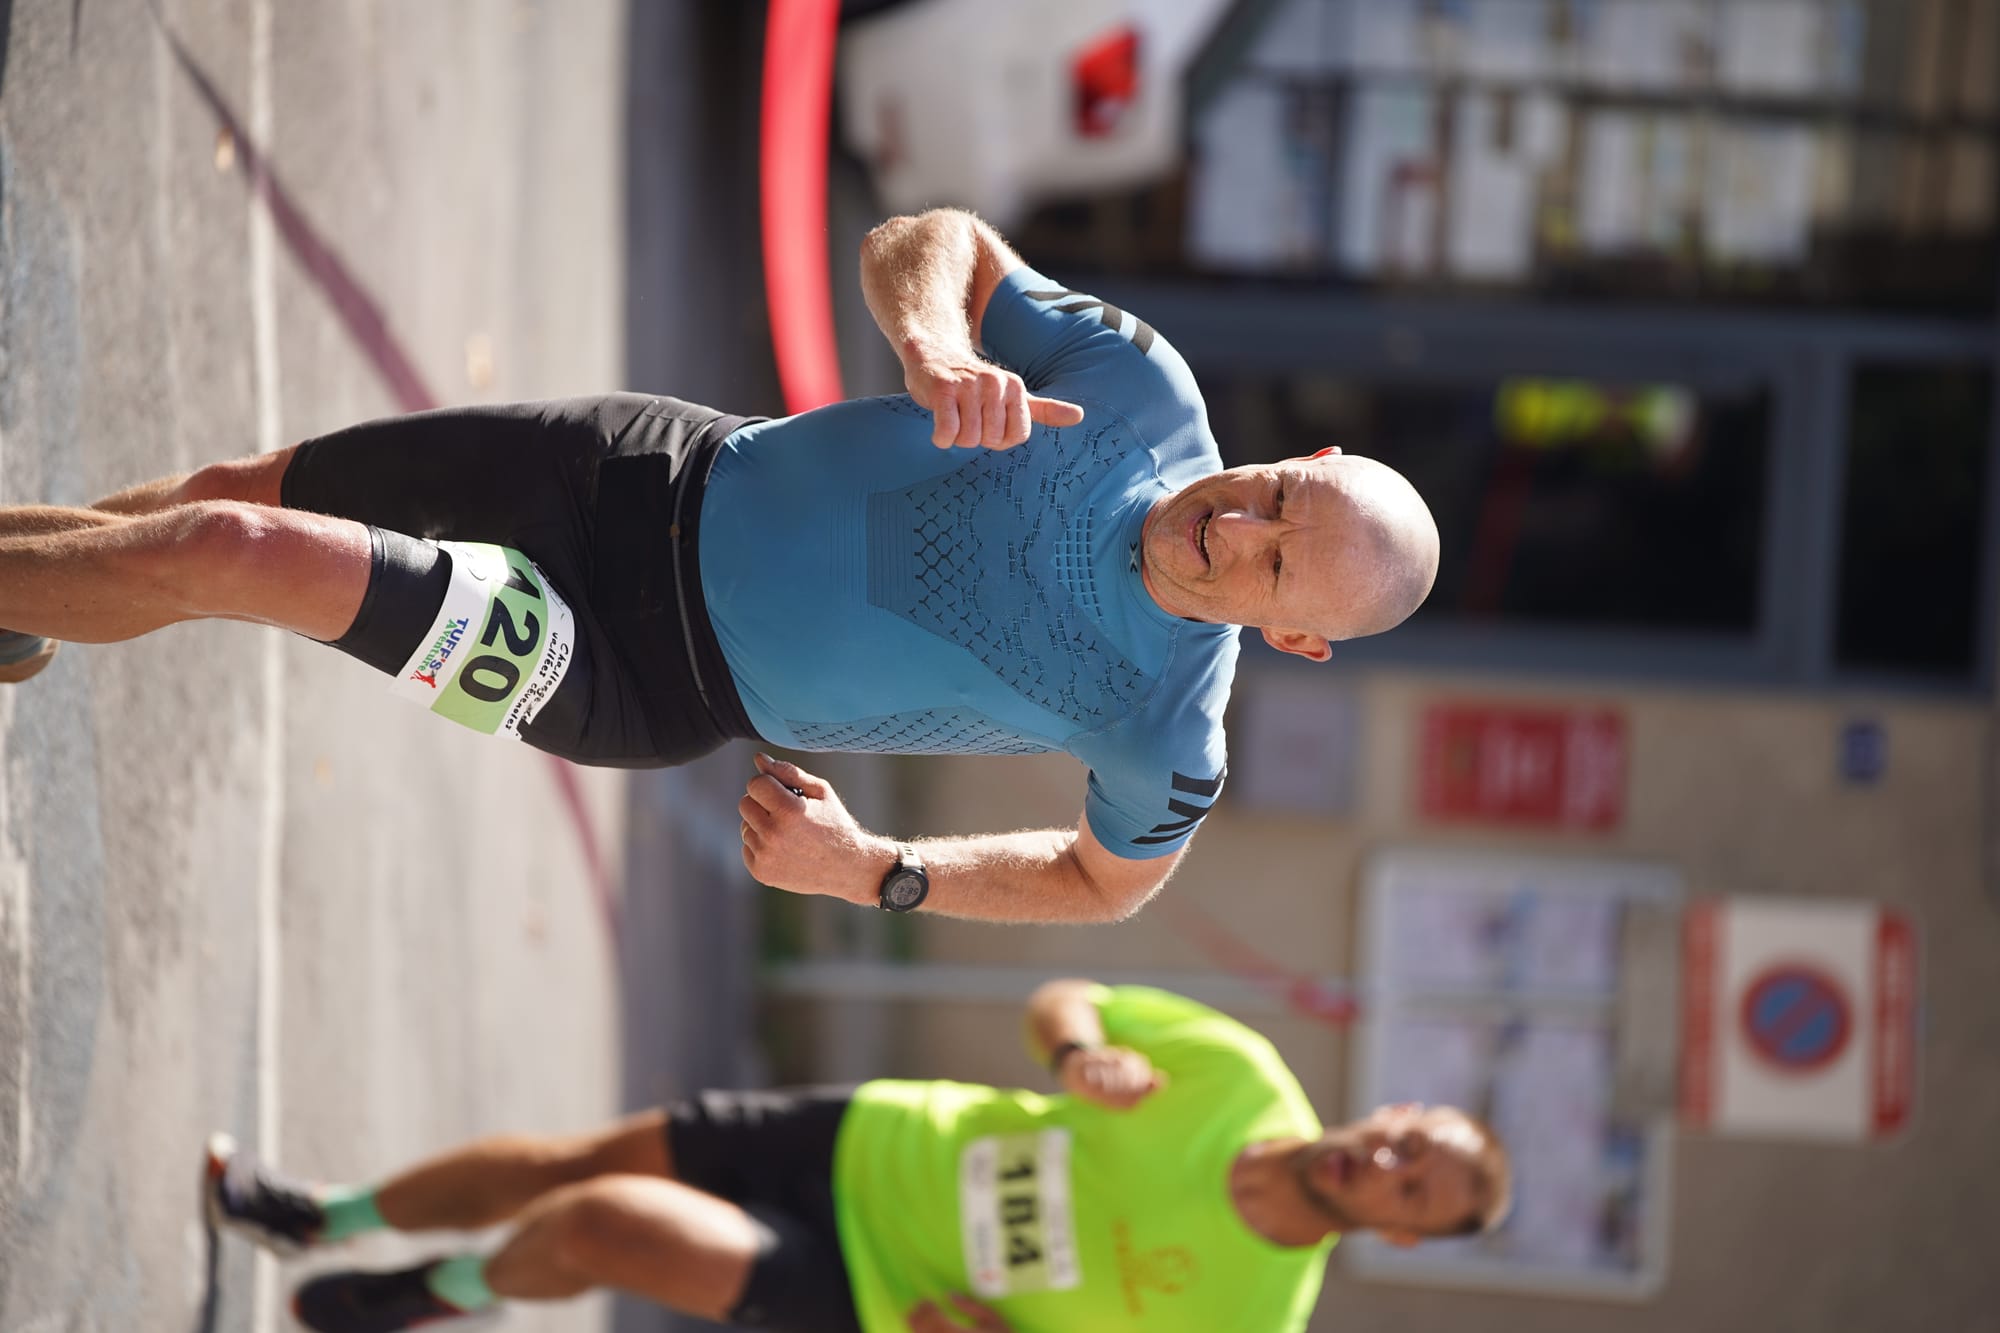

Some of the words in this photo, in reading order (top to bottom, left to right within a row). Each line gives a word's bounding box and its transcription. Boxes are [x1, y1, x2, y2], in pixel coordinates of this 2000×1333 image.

[418, 619, 458, 671] Aventure
[429, 617, 469, 670] TUFF'S
[459, 566, 541, 702] 120
[539, 632, 558, 678] vallées
[536, 643, 568, 702] Challenge
[506, 683, 537, 730] cévenoles
